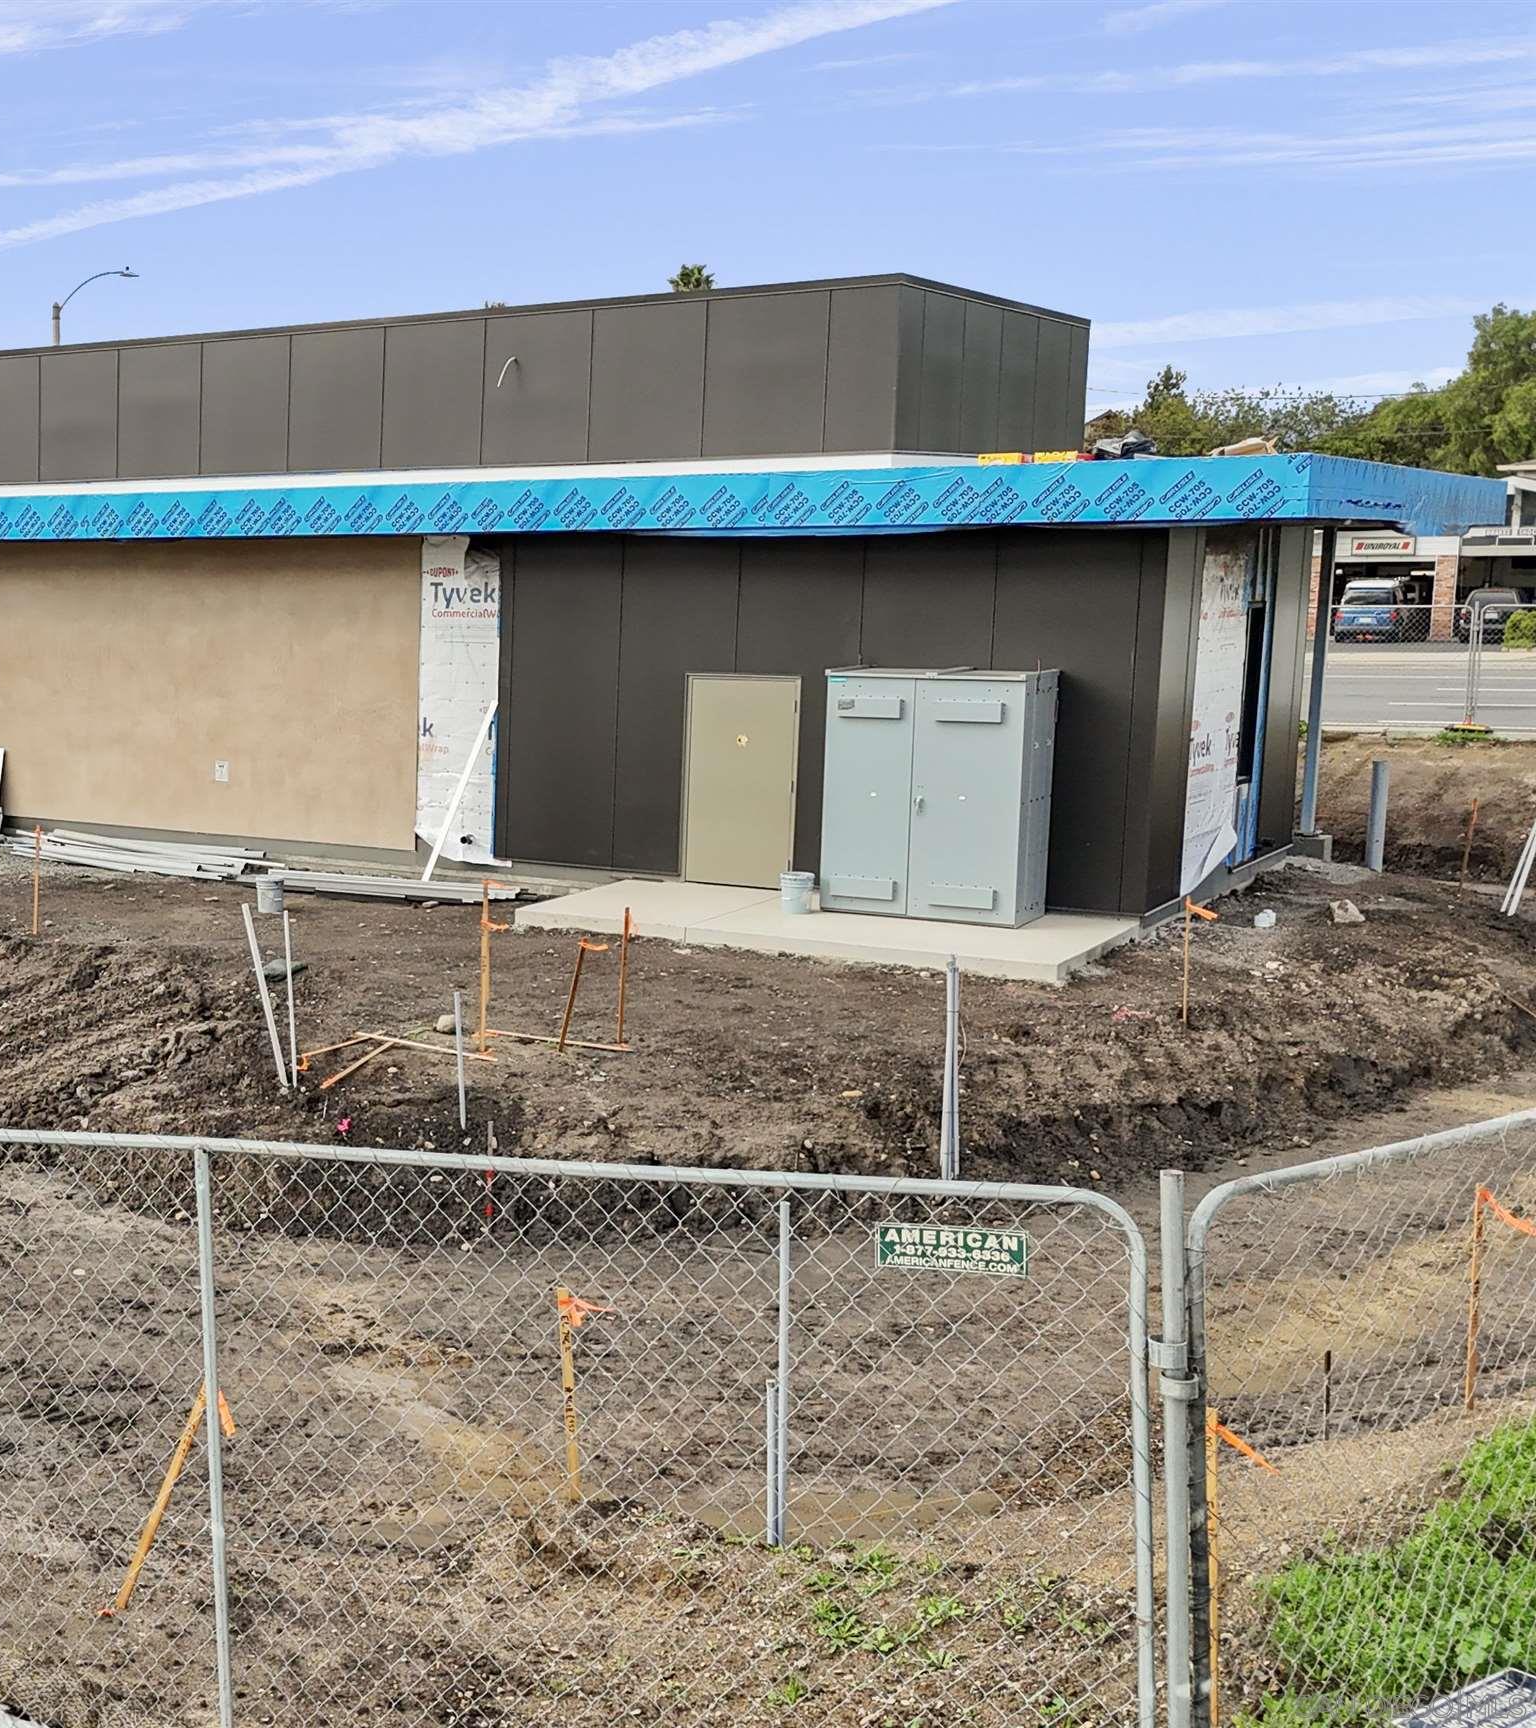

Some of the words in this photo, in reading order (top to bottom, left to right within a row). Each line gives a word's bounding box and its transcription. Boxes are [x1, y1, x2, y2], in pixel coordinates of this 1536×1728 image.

[560, 496, 586, 524] CCW-705
[607, 495, 635, 523] CCW-705
[656, 494, 684, 523] CCW-705
[706, 494, 736, 523] CCW-705
[774, 490, 803, 520] CCW-705
[828, 488, 859, 519] CCW-705
[883, 487, 915, 518] CCW-705
[941, 485, 974, 517] CCW-705
[980, 486, 1013, 518] CCW-705
[1040, 483, 1075, 516] CCW-705
[1104, 482, 1139, 514] CCW-705
[1168, 480, 1206, 513] CCW-705
[1235, 478, 1274, 513] CCW-705
[430, 581, 496, 609] Tyvek
[432, 608, 496, 618] CommercialW
[885, 1228, 1019, 1251] AMERICAN
[885, 1256, 1019, 1274] AMERICANFENCE.COM
